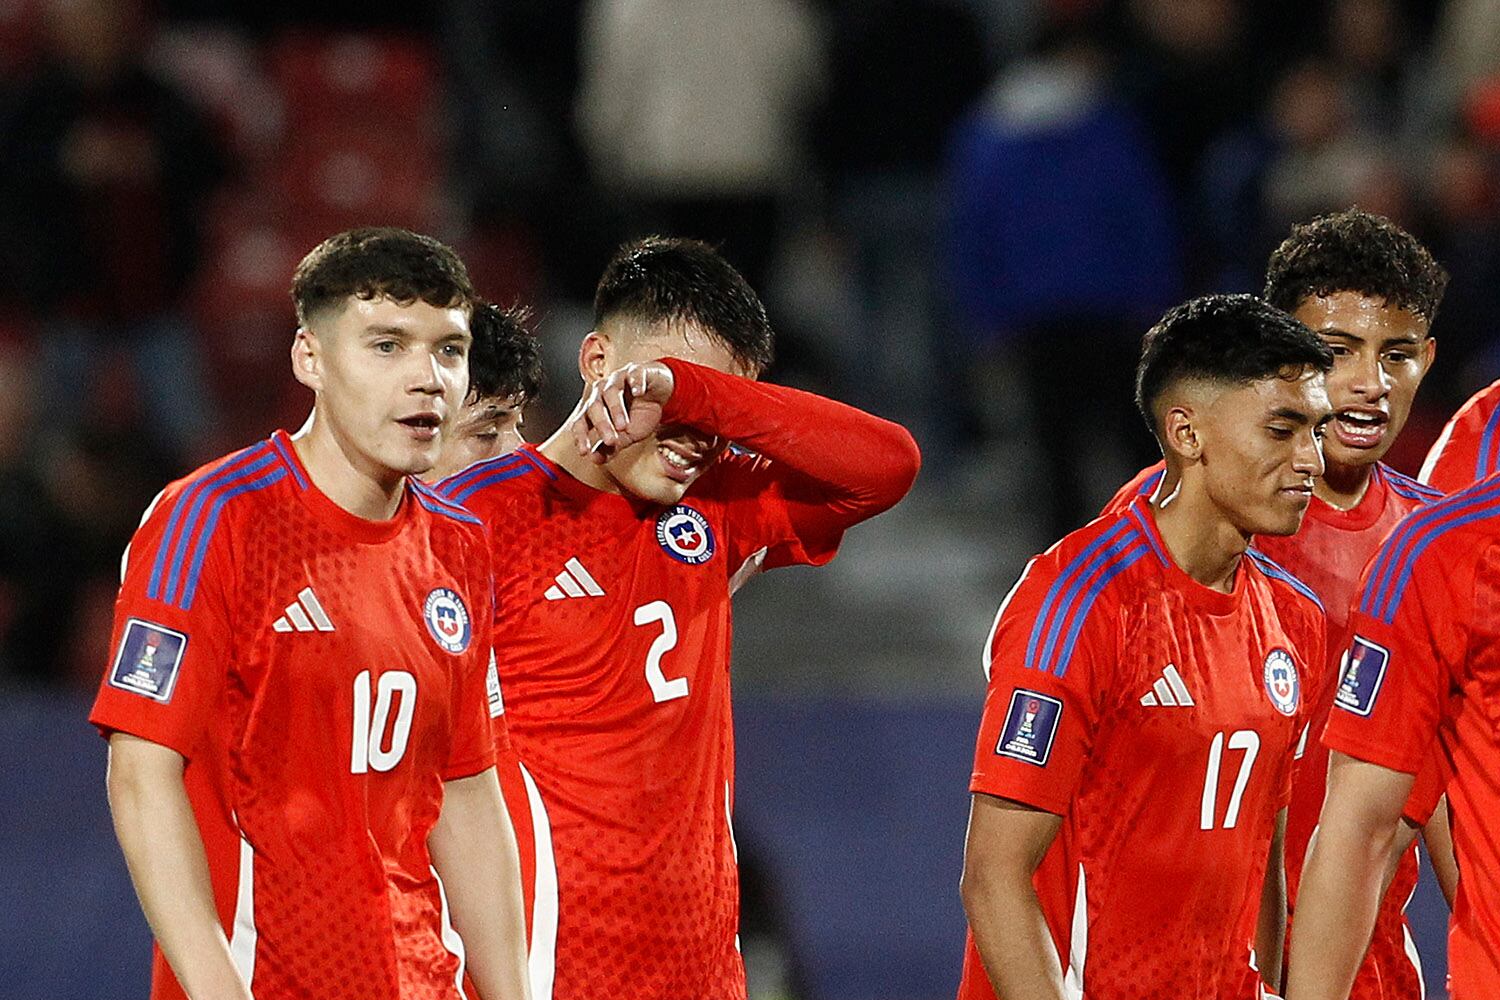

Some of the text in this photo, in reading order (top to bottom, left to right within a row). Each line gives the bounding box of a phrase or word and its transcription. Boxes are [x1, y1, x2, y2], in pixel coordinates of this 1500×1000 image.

[633, 600, 688, 703] 2
[350, 670, 417, 774] 10
[1200, 730, 1260, 830] 17
